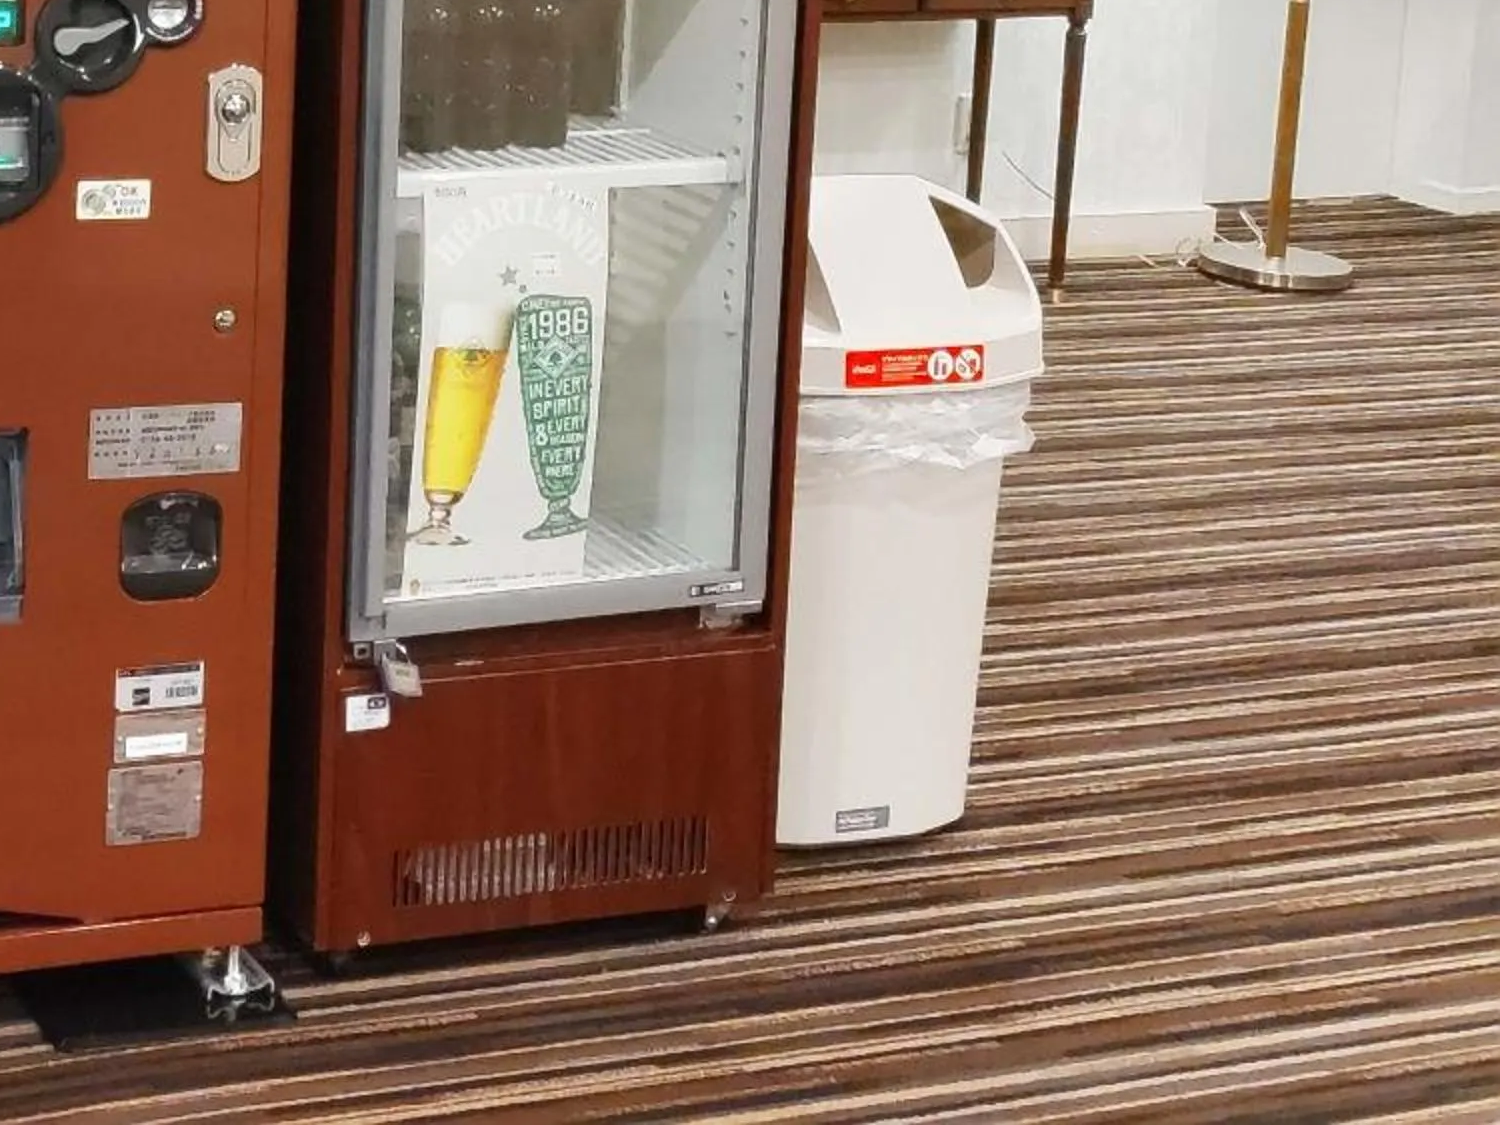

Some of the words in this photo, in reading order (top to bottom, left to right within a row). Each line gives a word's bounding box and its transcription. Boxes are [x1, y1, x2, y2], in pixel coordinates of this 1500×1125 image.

[529, 307, 589, 340] 1986
[545, 375, 588, 397] EVERY
[532, 395, 580, 419] SPIRIT
[536, 423, 549, 446] &
[547, 416, 587, 433] EVERY
